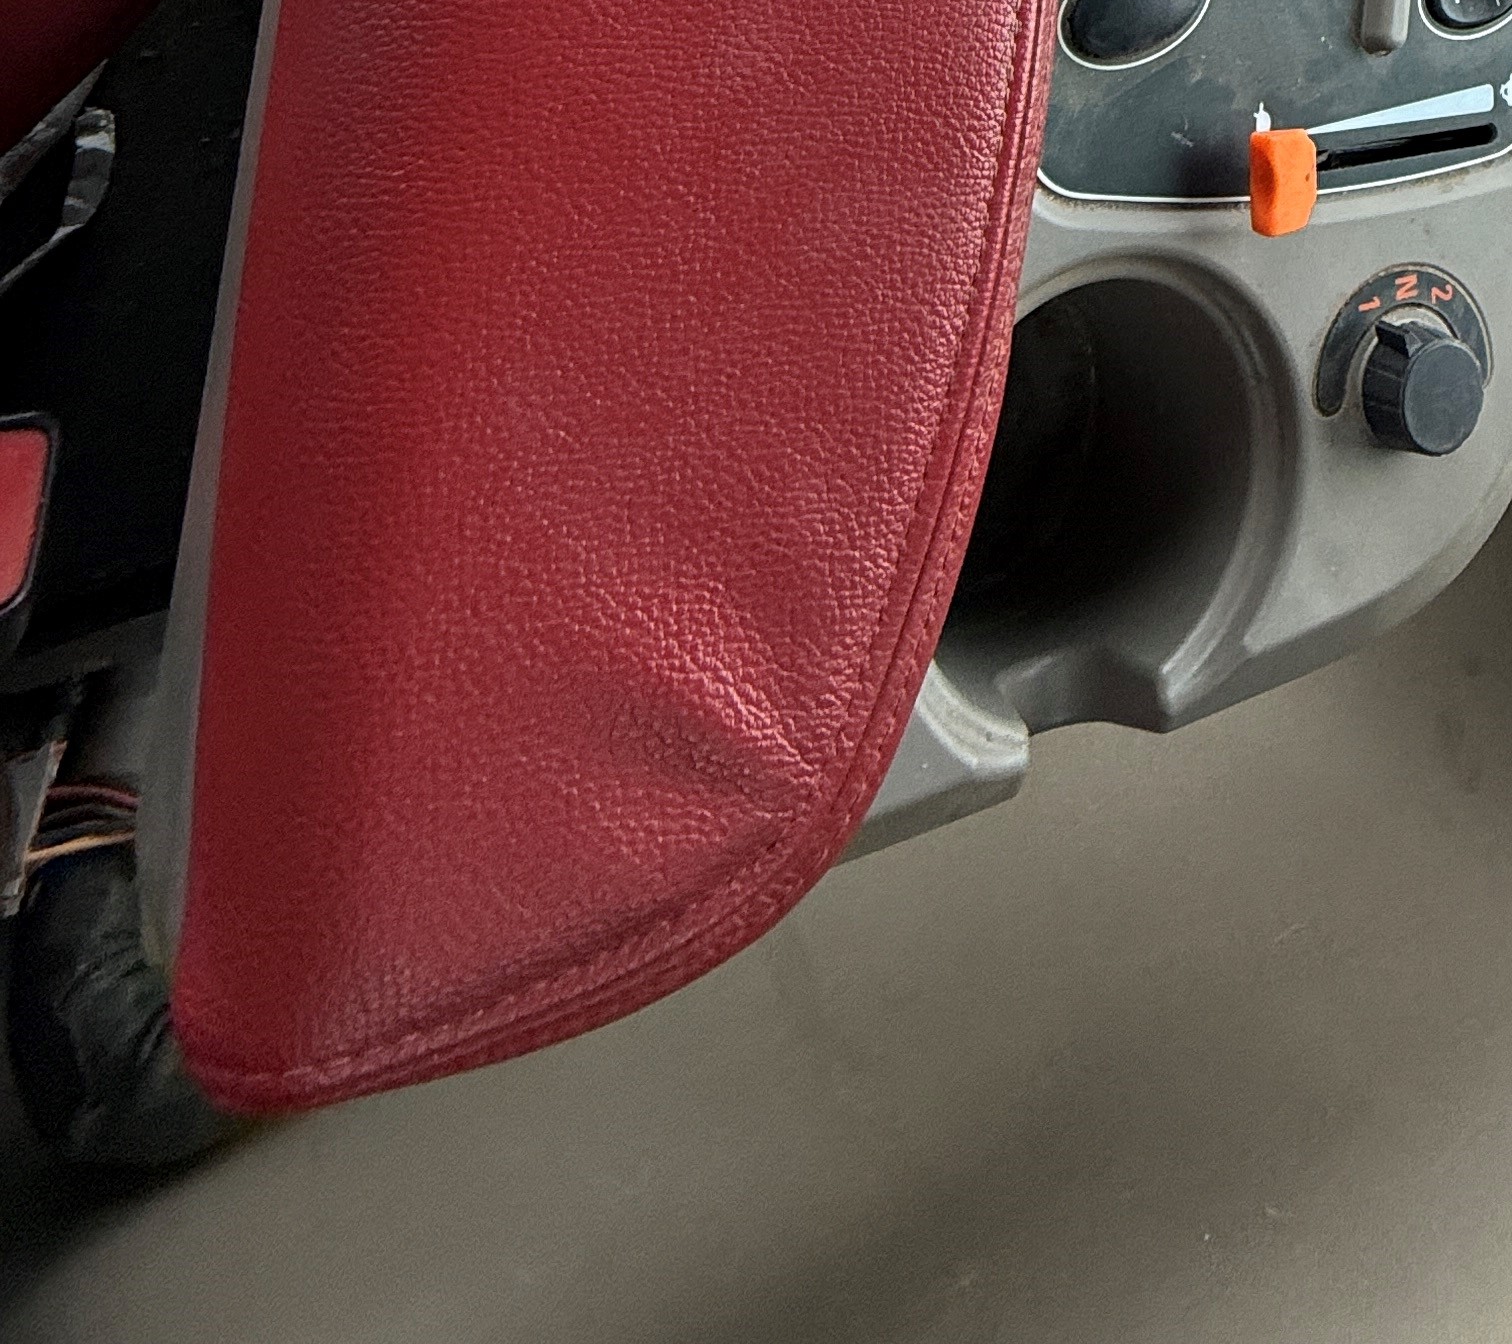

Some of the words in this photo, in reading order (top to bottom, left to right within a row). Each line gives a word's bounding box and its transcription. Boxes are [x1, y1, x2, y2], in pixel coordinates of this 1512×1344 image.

[1358, 296, 1381, 312] 1
[1395, 274, 1419, 301] N
[1431, 284, 1453, 304] 2
